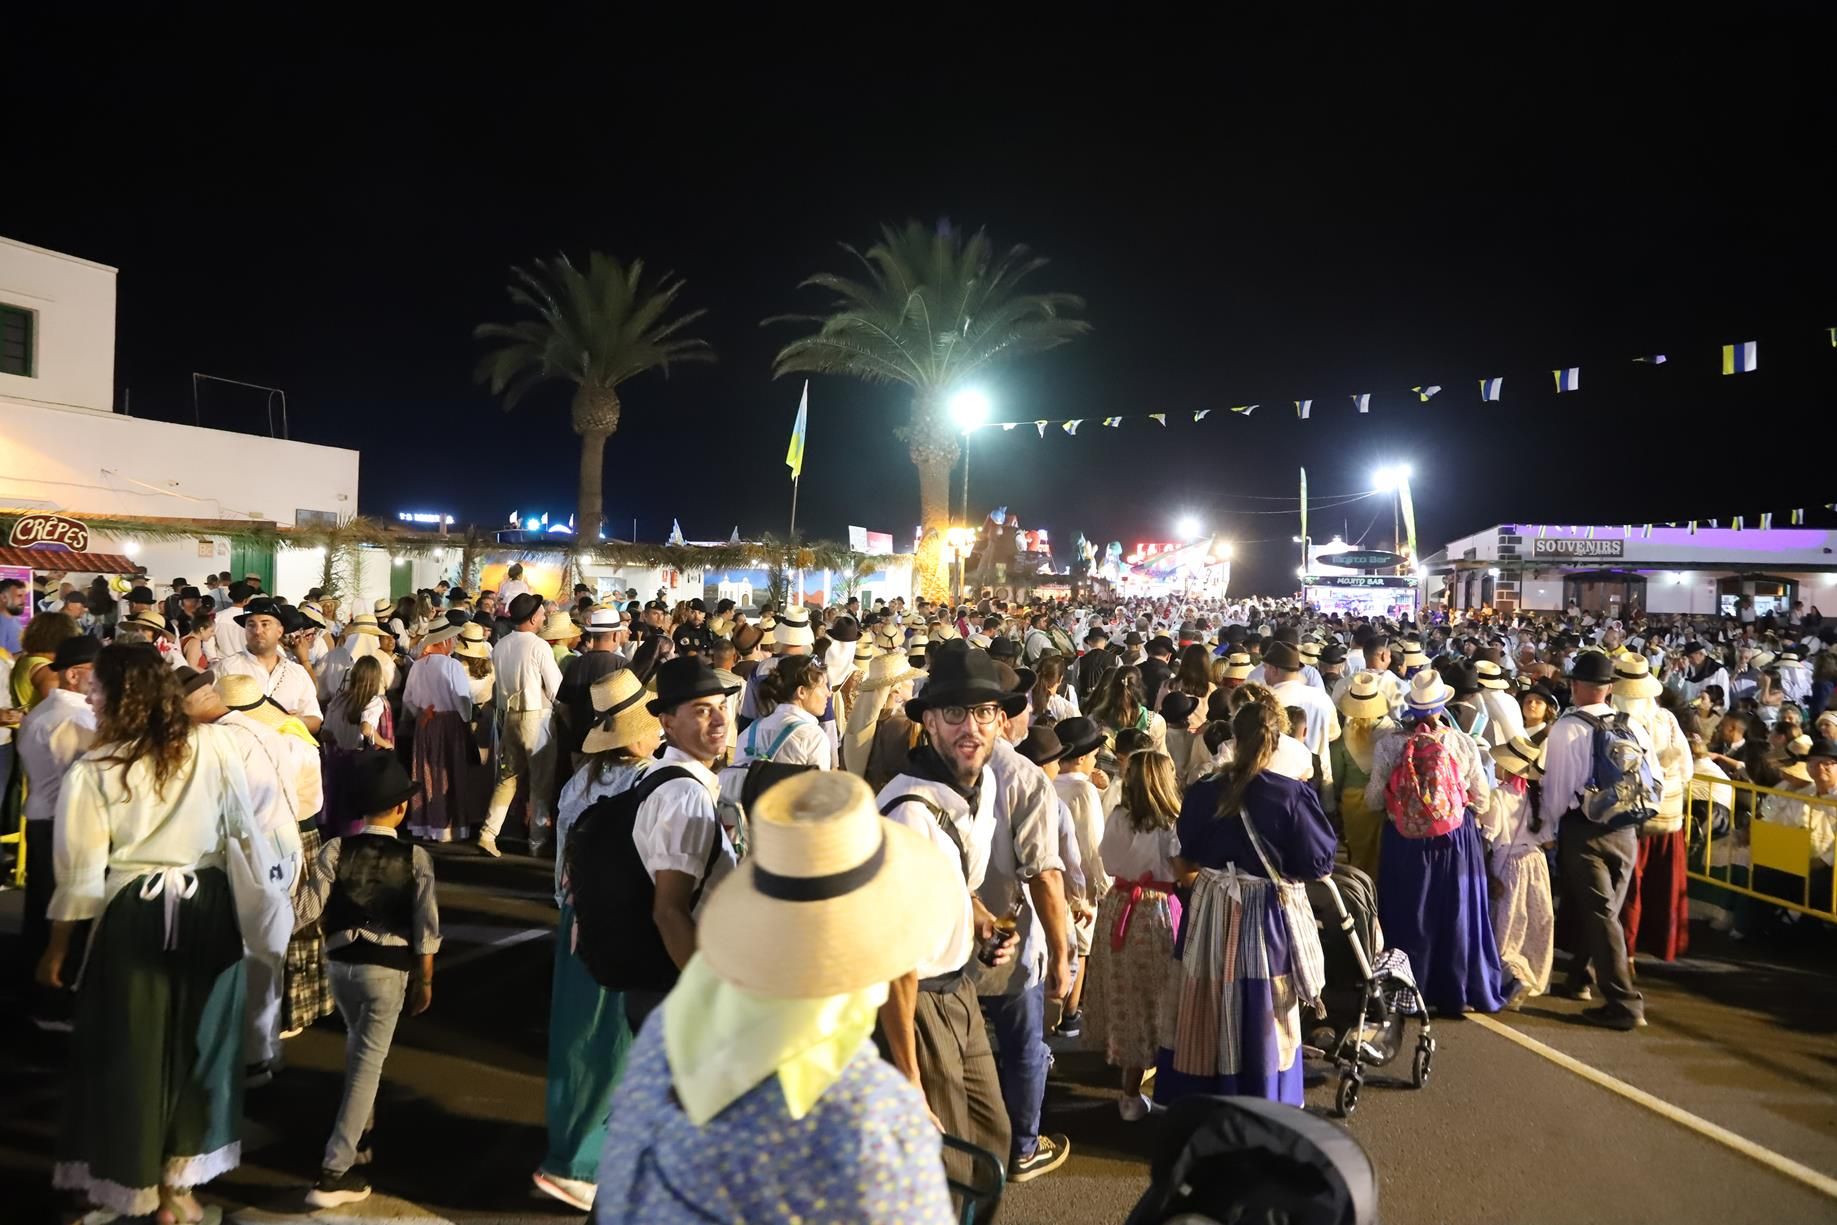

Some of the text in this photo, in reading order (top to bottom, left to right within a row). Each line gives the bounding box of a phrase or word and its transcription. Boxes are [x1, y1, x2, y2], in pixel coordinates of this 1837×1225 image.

[16, 517, 88, 548] CRÊPES
[1536, 540, 1621, 554] SOUVENIRS
[1337, 578, 1366, 586] MOJITO
[1367, 578, 1385, 586] BAR
